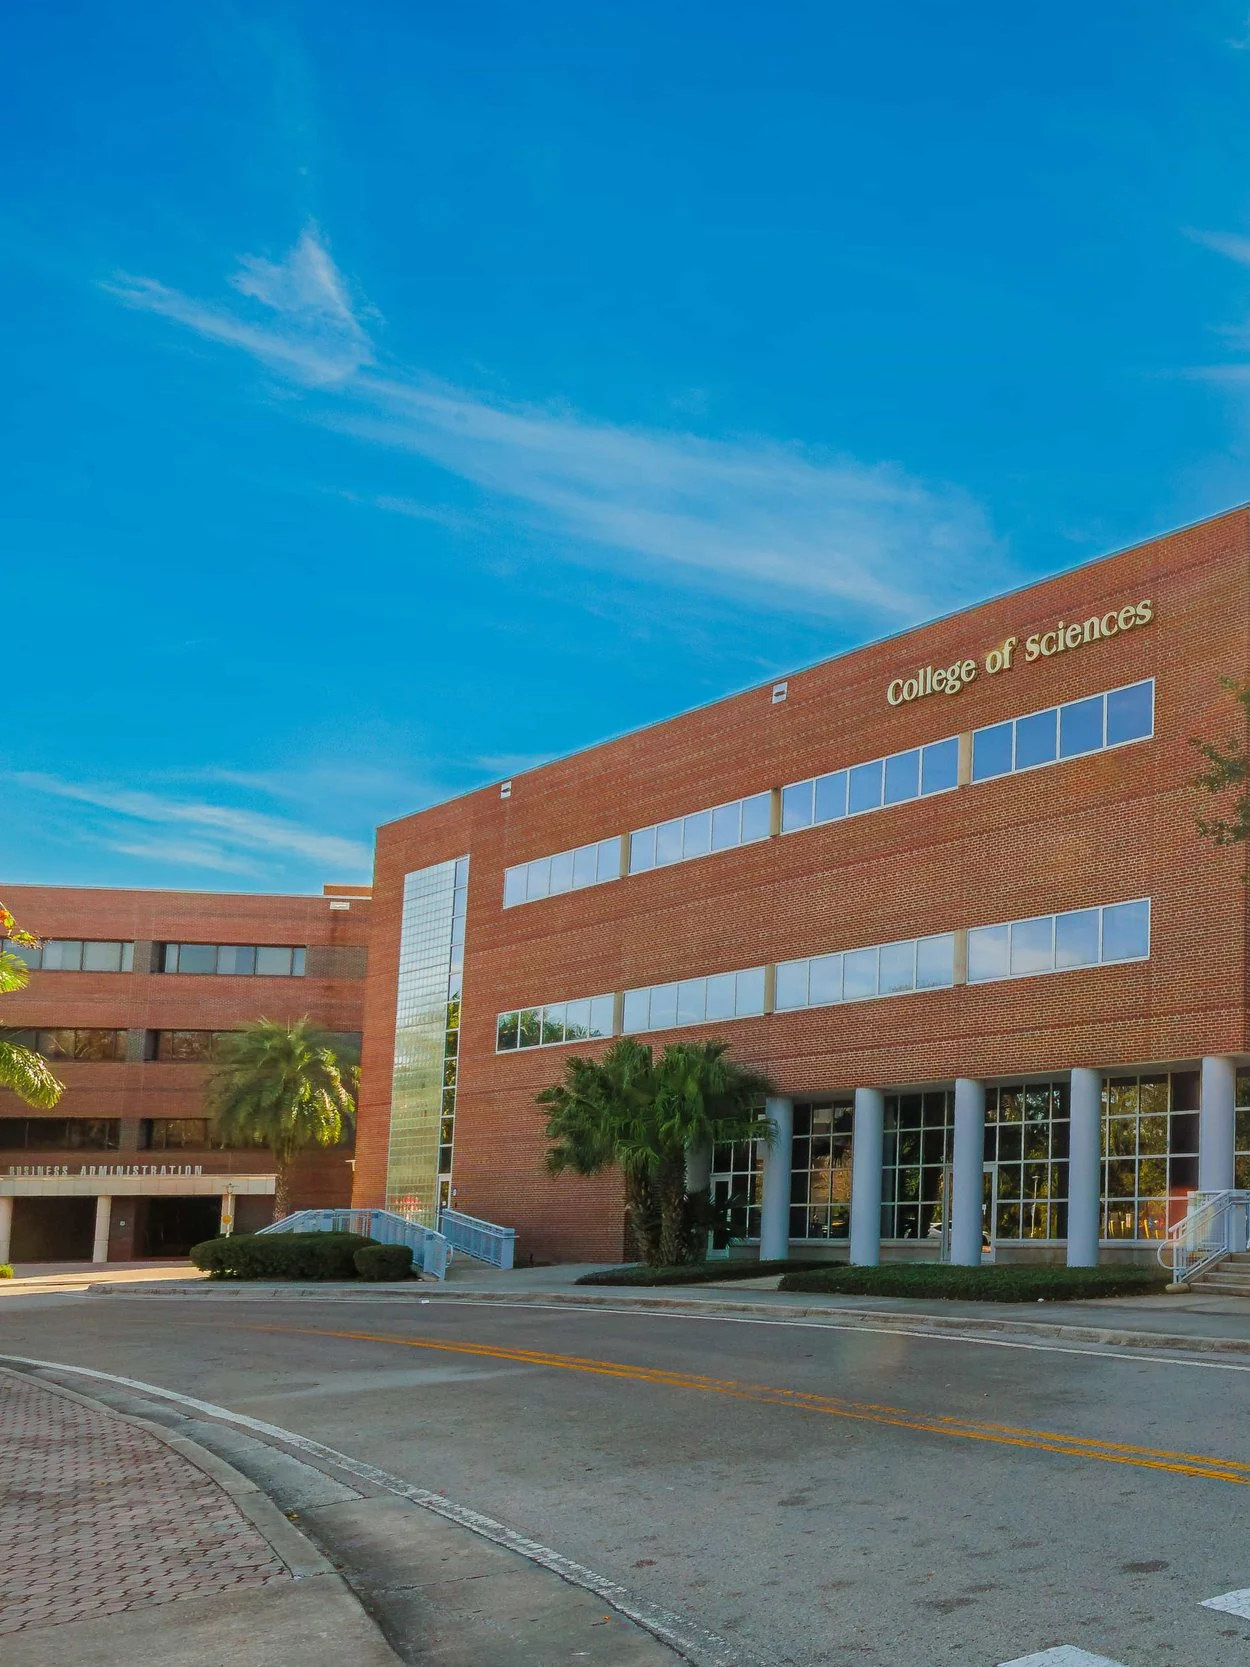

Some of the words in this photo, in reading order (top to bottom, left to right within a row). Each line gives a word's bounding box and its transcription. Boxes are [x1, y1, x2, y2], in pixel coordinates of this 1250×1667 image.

[887, 659, 977, 706] College
[985, 636, 1018, 674] of
[9, 1165, 69, 1177] BUSINESS
[80, 1165, 203, 1177] ADMINISTRATION
